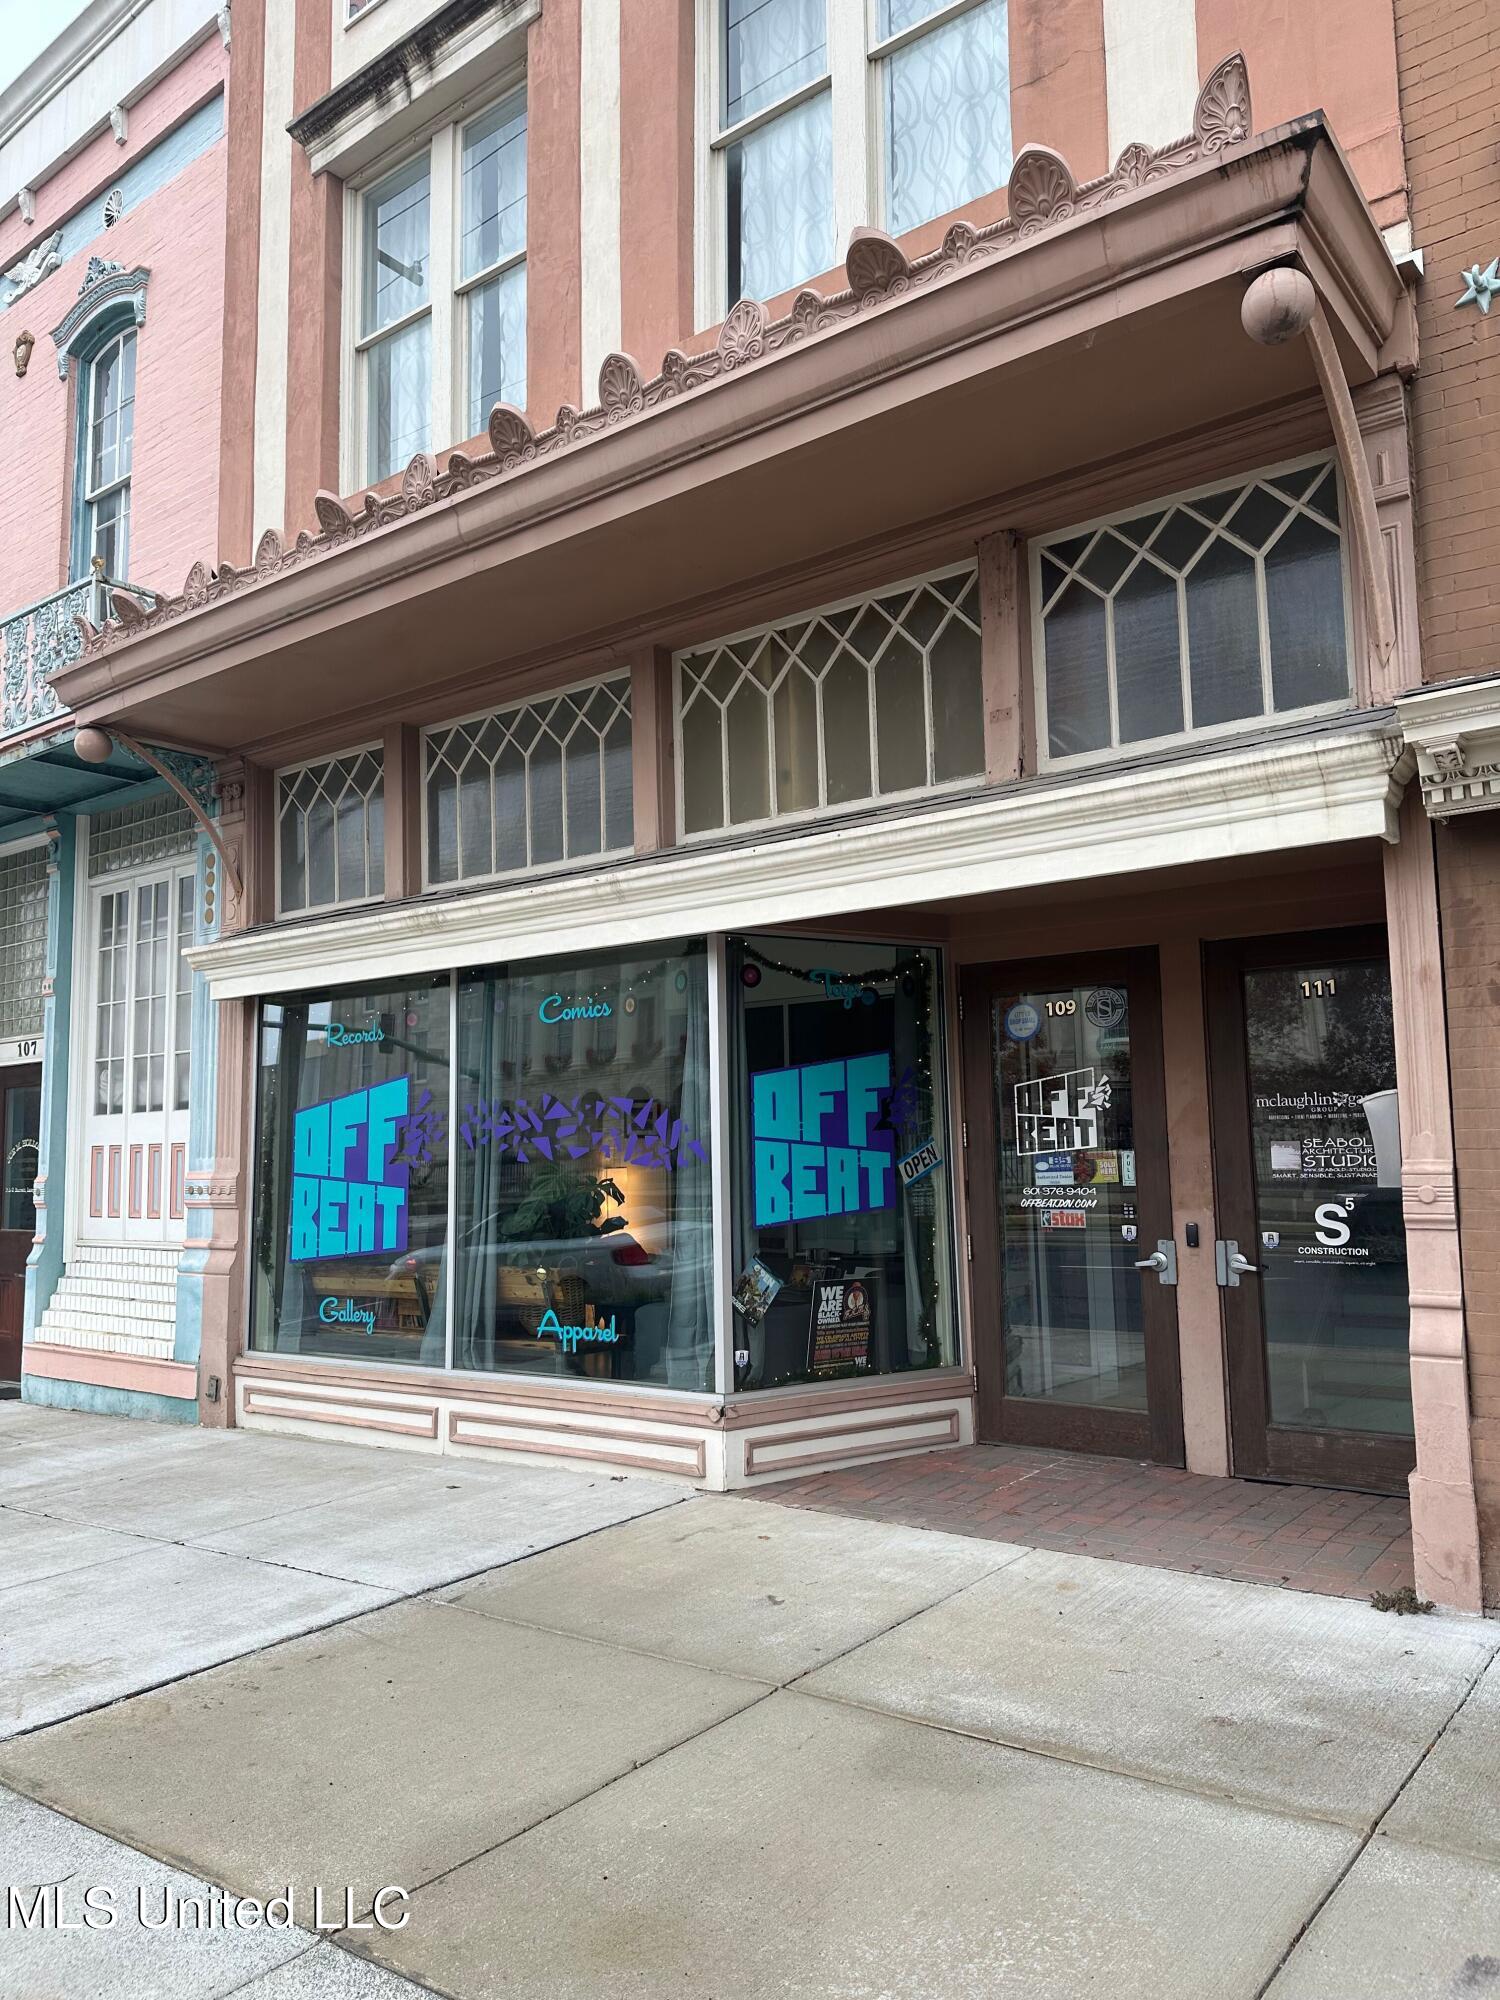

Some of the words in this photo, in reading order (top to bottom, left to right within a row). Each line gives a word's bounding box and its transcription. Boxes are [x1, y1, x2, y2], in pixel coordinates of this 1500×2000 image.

[1301, 978, 1336, 998] 111
[539, 995, 612, 1024] Comics
[1045, 999, 1077, 1017] 109
[325, 1020, 385, 1048] Records
[17, 1040, 37, 1057] 107
[753, 1052, 890, 1148] OFF
[1016, 1068, 1094, 1118] OFF
[1256, 1091, 1333, 1109] mclaughlin
[294, 1077, 408, 1183] OFF
[1017, 1115, 1094, 1154] BEAT
[1302, 1137, 1374, 1148] SEABOL
[1302, 1147, 1376, 1155] ARCHITECTUR
[903, 1143, 938, 1179] OPEN
[753, 1140, 891, 1226] BEAT
[291, 1176, 405, 1261] BEAT
[1298, 1246, 1369, 1256] CONSTRUCTION
[820, 1285, 844, 1301] WE
[319, 1296, 376, 1335] Gallery
[817, 1310, 841, 1319] BLACK-
[818, 1299, 843, 1312] ARE
[537, 1309, 619, 1354] Apparel
[854, 1356, 867, 1365] WE
